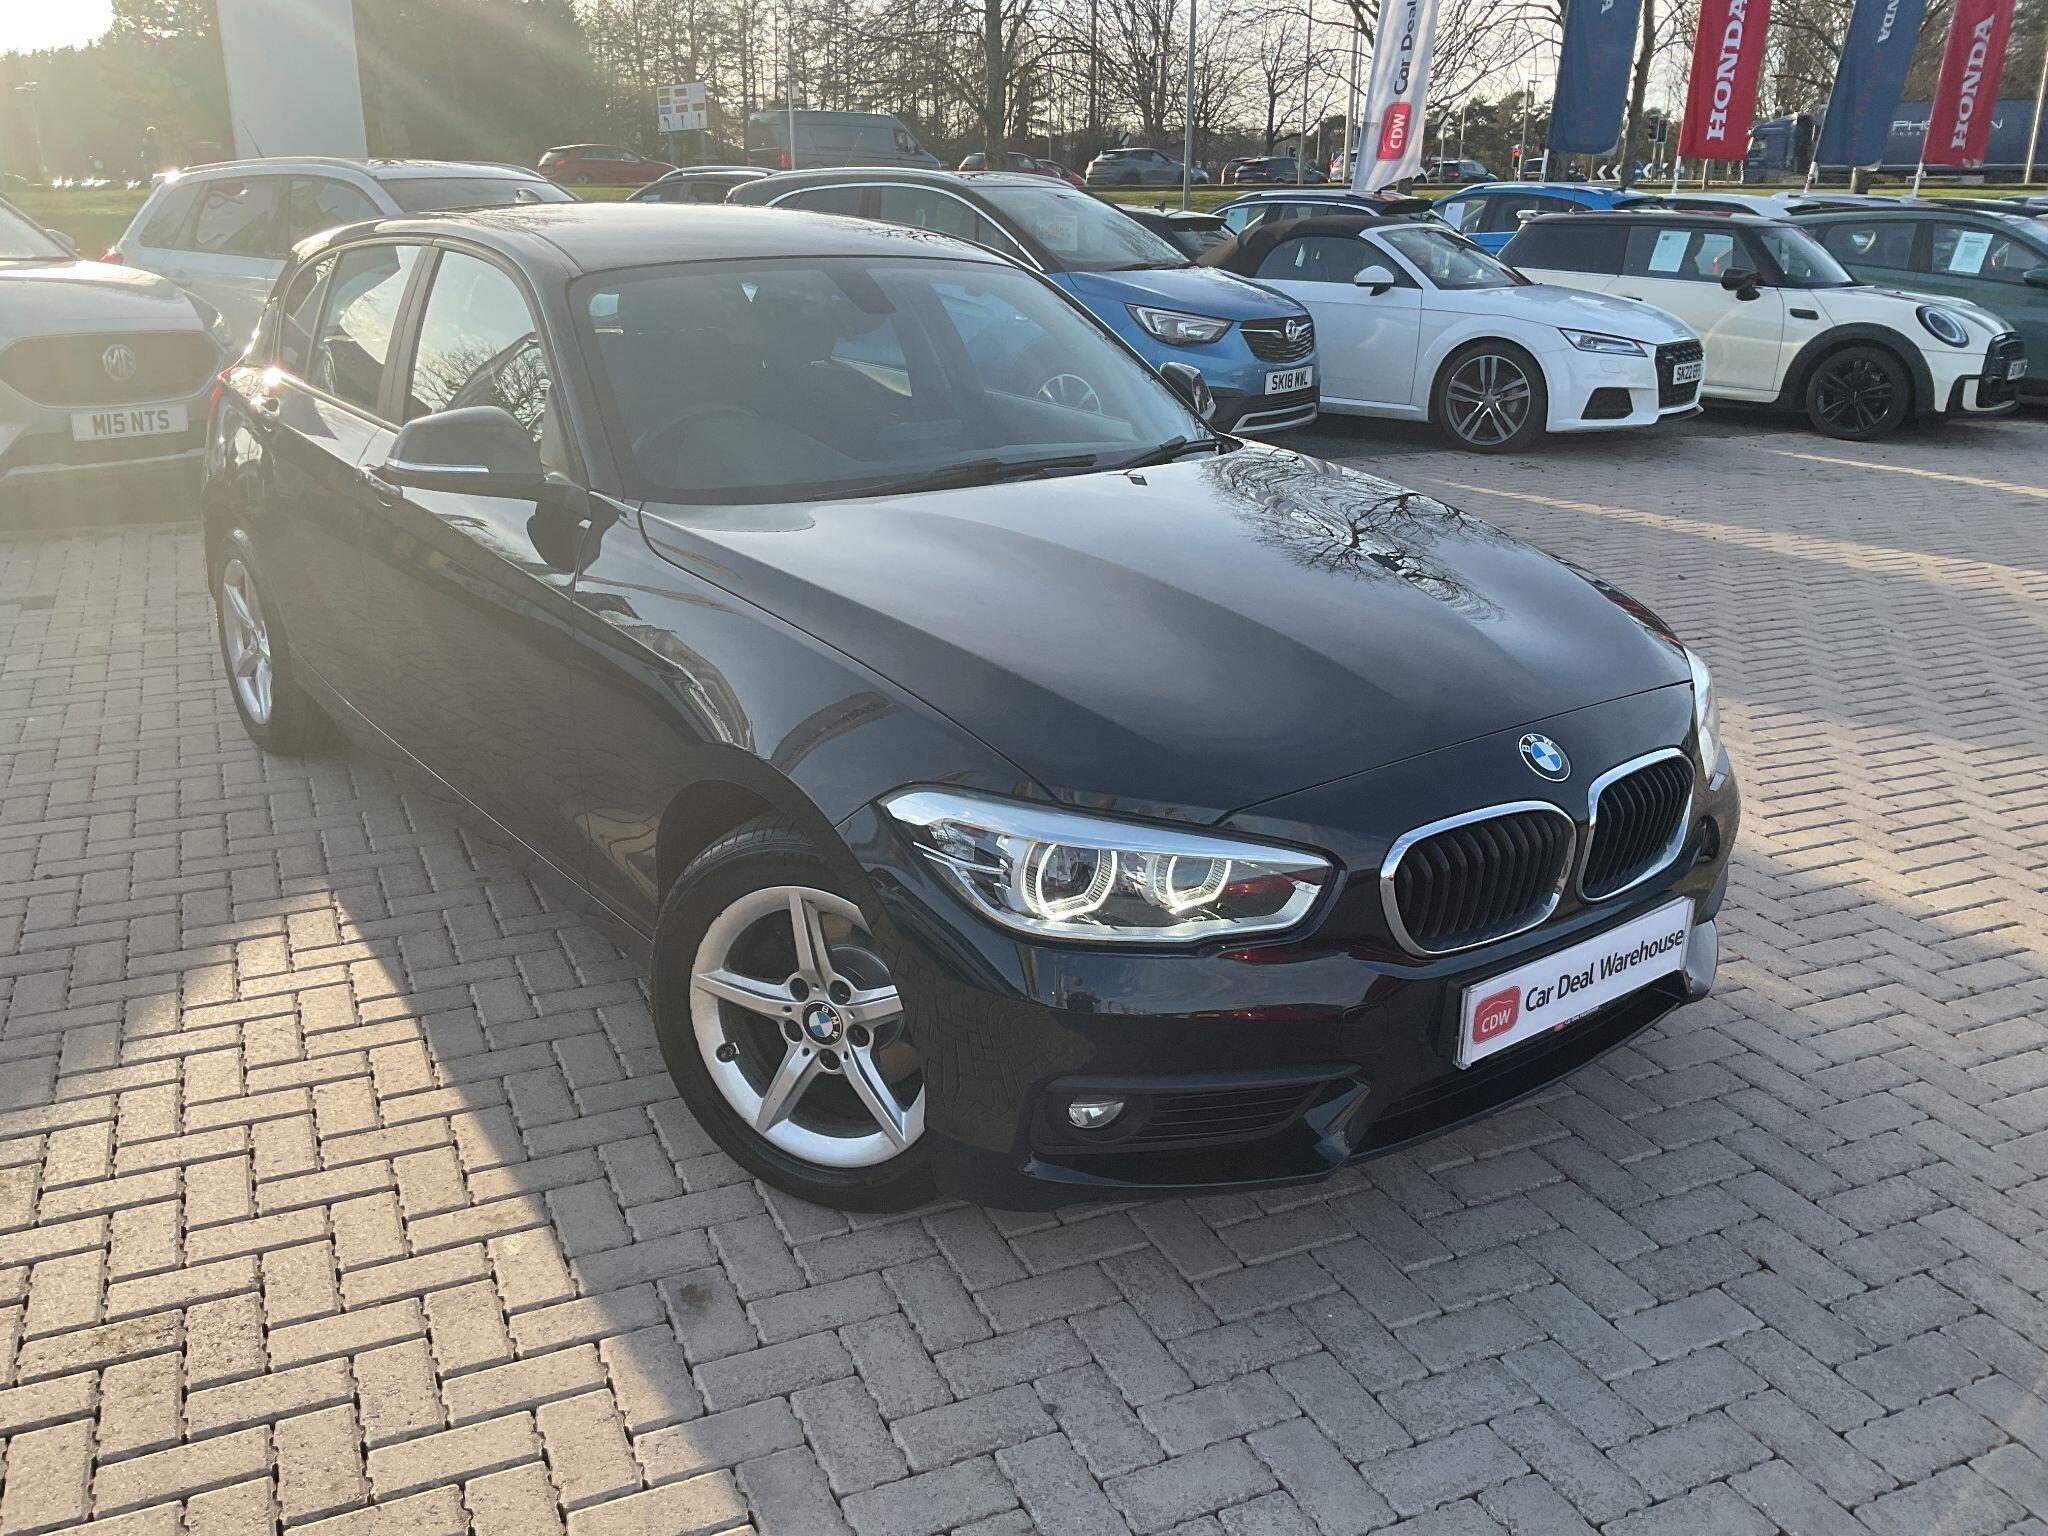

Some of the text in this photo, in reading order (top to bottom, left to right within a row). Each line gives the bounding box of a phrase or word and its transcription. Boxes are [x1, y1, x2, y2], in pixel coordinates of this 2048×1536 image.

[1394, 0, 1417, 95] Car Deal
[1706, 0, 1747, 141] HONDA
[1951, 14, 1995, 150] HONDA
[1390, 113, 1405, 150] CDW
[1271, 372, 1294, 391] SK18
[1676, 364, 1693, 381] SK22
[92, 409, 170, 436] M15 NTS
[1525, 929, 1684, 1012] Car Deal Warehouse
[1481, 1008, 1511, 1033] CDW
